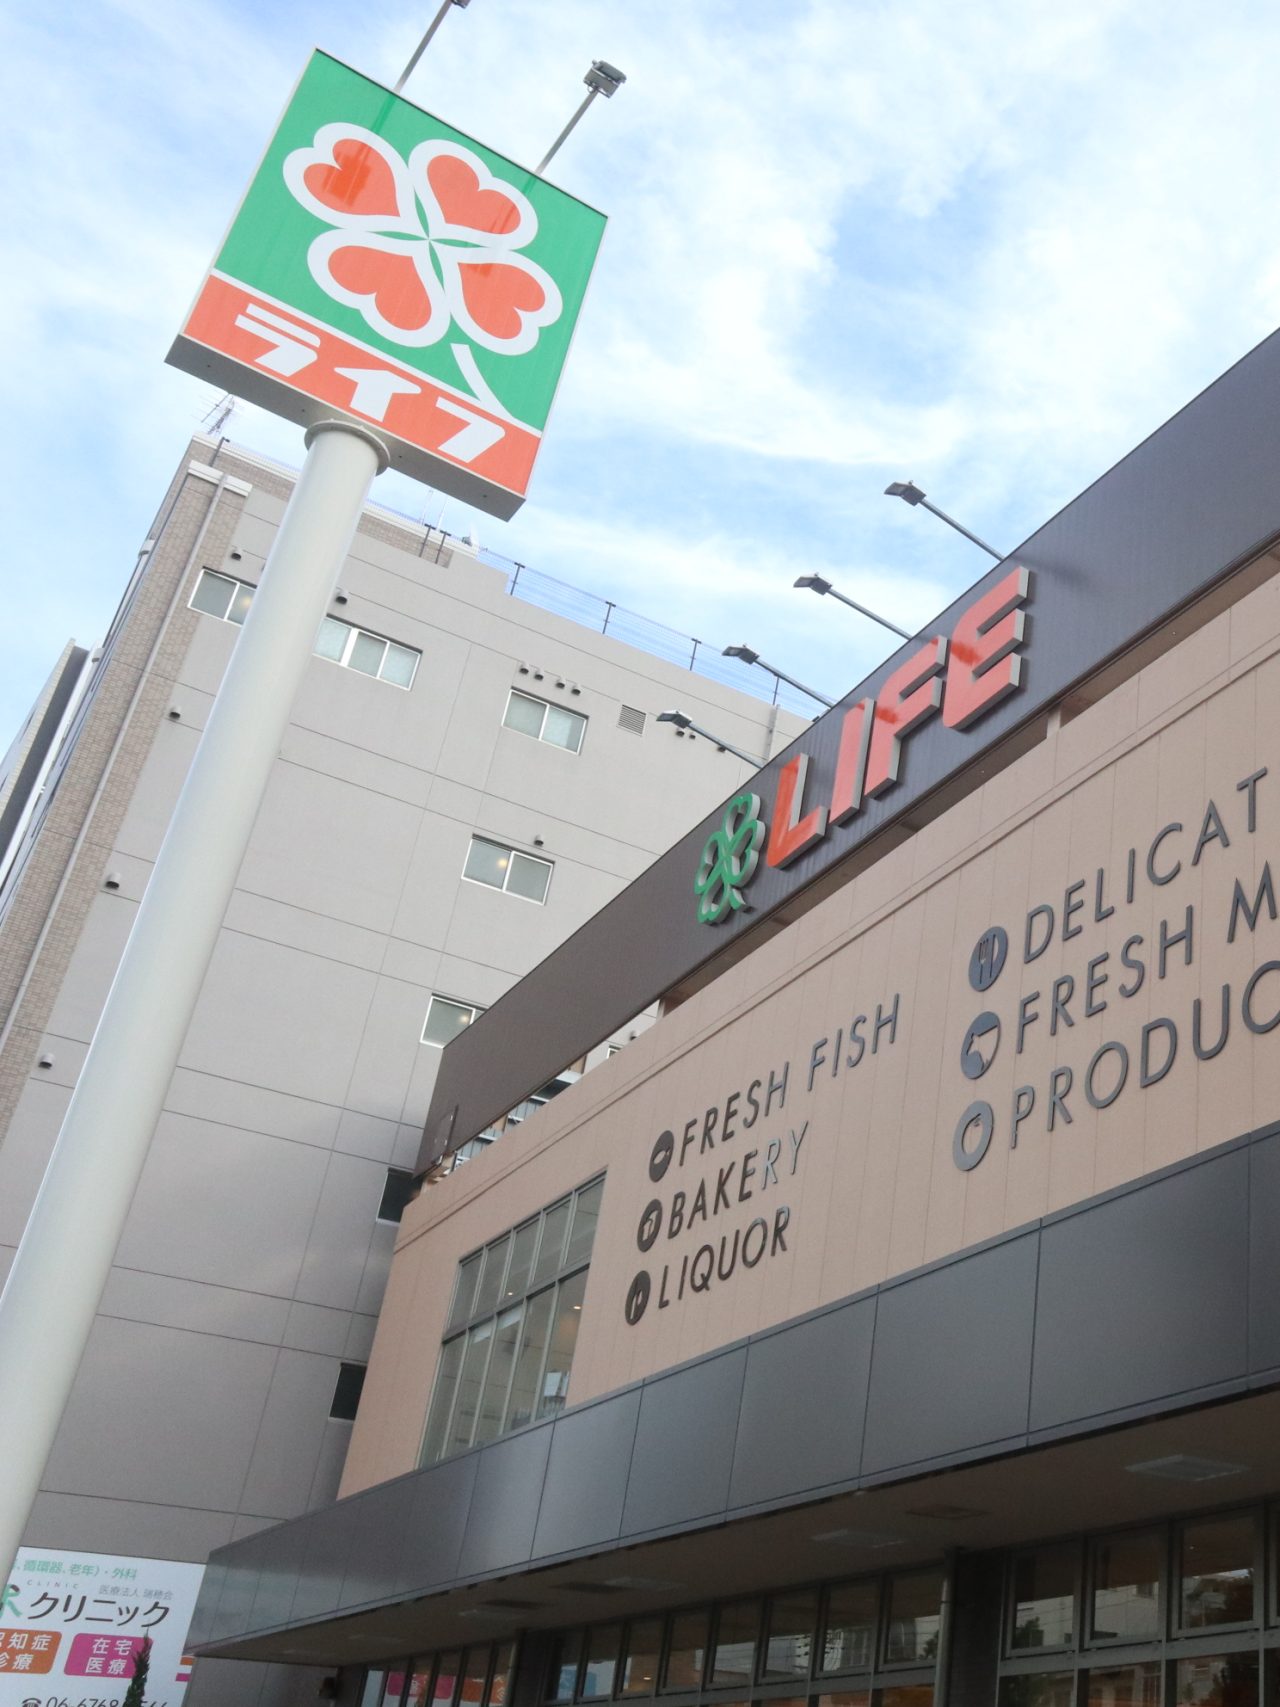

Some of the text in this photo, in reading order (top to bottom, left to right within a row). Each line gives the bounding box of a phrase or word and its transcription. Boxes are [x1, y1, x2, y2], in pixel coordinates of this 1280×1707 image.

[234, 302, 506, 464] ライフ
[766, 566, 1029, 869] LIFE
[1016, 904, 1194, 1054] FRESH
[679, 993, 900, 1166] FRESH FISH
[667, 1120, 809, 1240] BAKERY
[658, 1206, 790, 1309] LIQUOR
[28, 1592, 169, 1627] クリニック
[85, 1656, 127, 1675] 医療
[92, 1637, 133, 1656] 在宅
